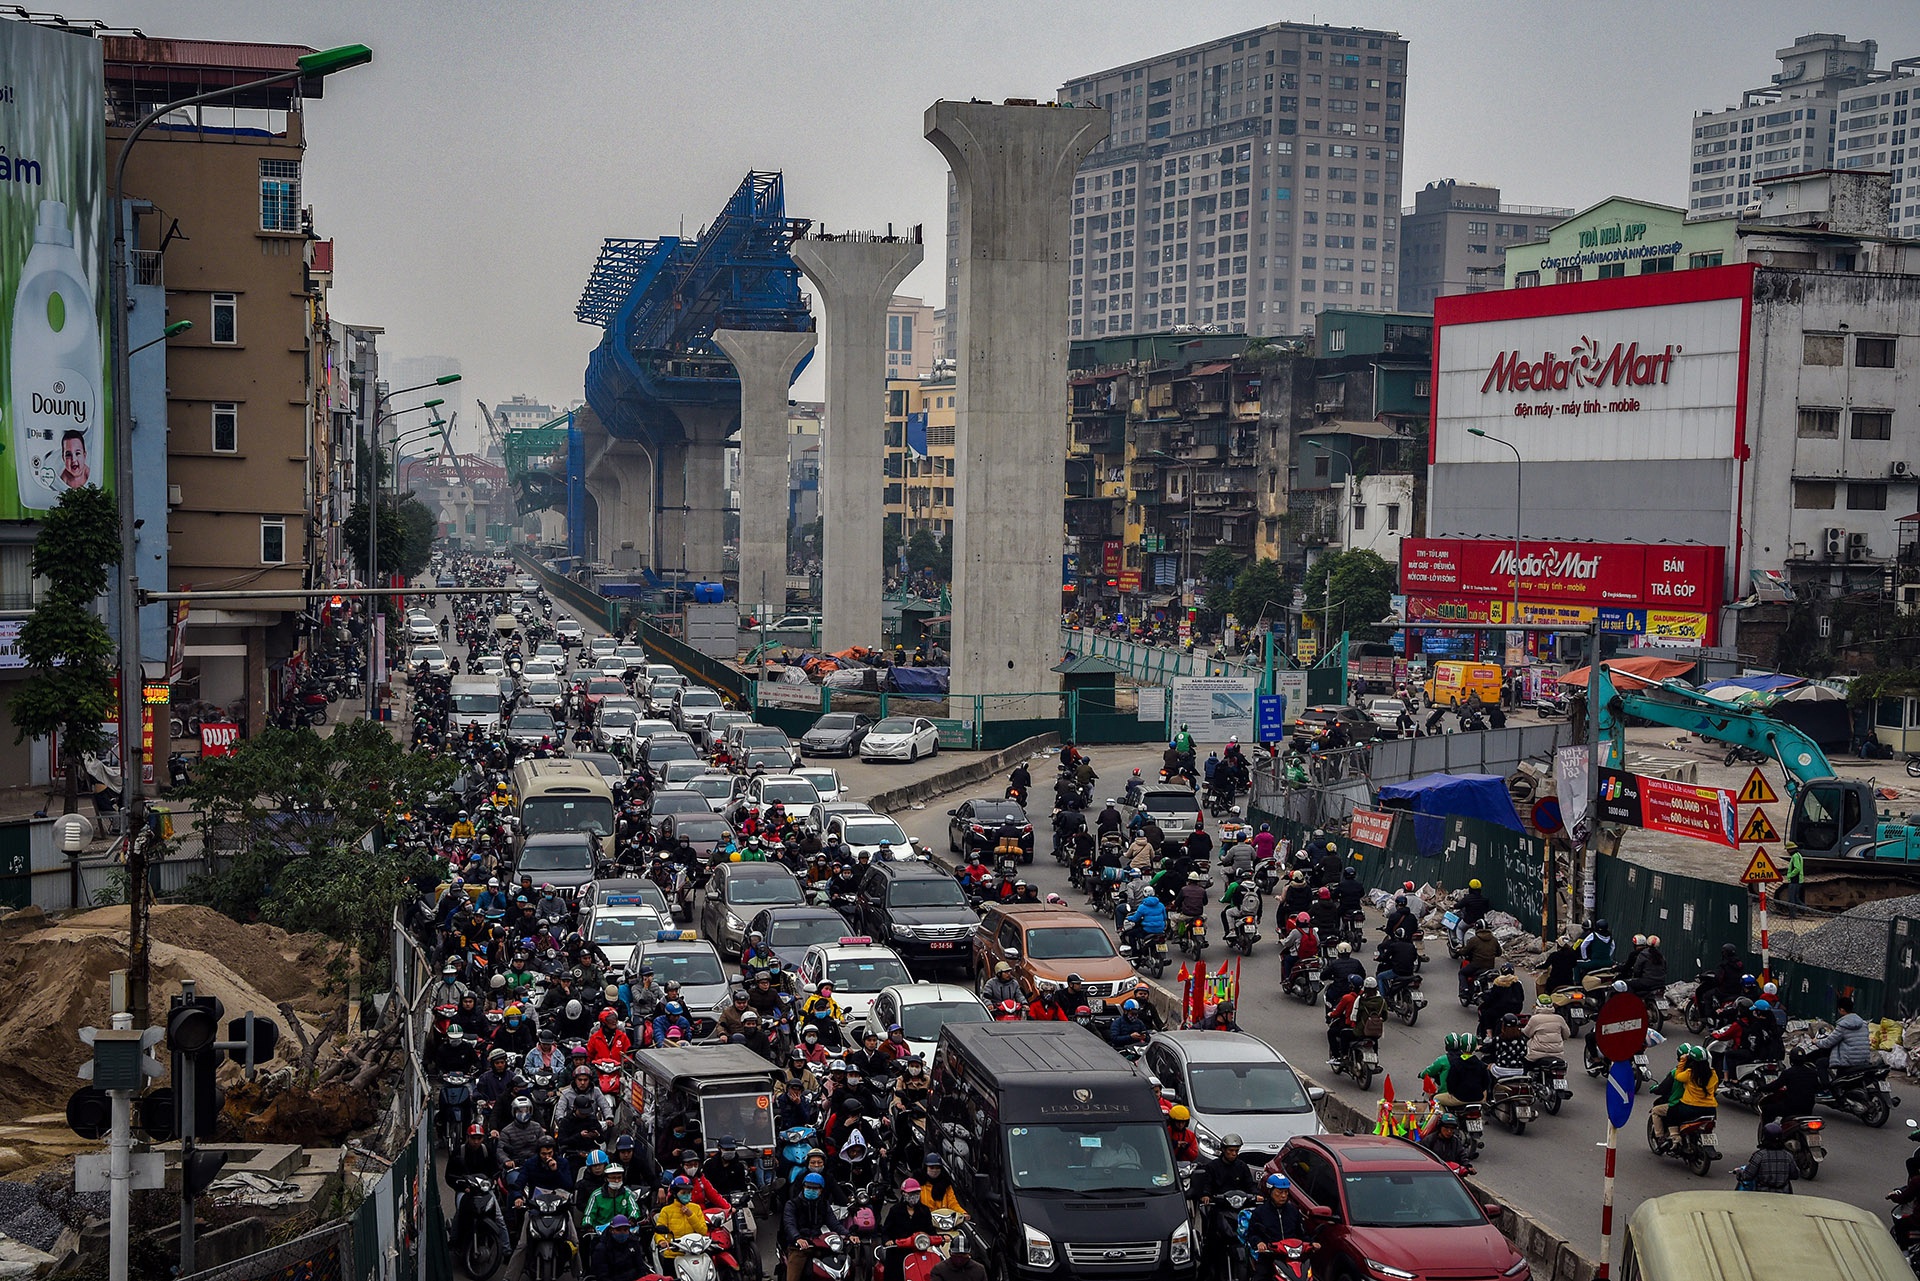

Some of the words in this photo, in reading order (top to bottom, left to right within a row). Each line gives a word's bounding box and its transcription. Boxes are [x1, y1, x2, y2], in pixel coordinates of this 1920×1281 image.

[1578, 227, 1598, 248] TOÀ
[1600, 223, 1622, 246] NHÀ
[1624, 223, 1646, 243] APP
[1541, 257, 1560, 269] CÔNG
[1561, 257, 1570, 267] TY
[1600, 251, 1613, 263] BAO
[1636, 243, 1658, 258] NÔNG
[1480, 350, 1571, 393] Media
[1594, 341, 1675, 388] Mart
[32, 392, 86, 423] Downy
[1514, 401, 1532, 418] điện
[1534, 401, 1554, 418] máy
[1561, 400, 1581, 417] máy
[1583, 399, 1601, 414] tính
[1609, 397, 1640, 413] mobile
[1490, 549, 1542, 577] Media
[1555, 551, 1599, 579] Mart
[1663, 557, 1685, 573] BÁN
[1520, 580, 1533, 591] máy
[1538, 581, 1550, 592] máy
[1566, 583, 1586, 592] mobile
[1651, 580, 1672, 596] TRẢ
[1673, 580, 1696, 597] GÓP
[1438, 601, 1456, 619] GIẢM
[1456, 602, 1468, 620] GIÁ
[1491, 610, 1502, 618] 50%
[1656, 624, 1673, 635] 30%
[1678, 625, 1696, 637] 50%
[1600, 780, 1622, 797] FPT
[1624, 788, 1637, 799] Shop
[1648, 780, 1662, 788] Xiaomi
[1668, 783, 1674, 791] A2
[1674, 784, 1682, 792] Lite
[1618, 807, 1629, 817] 6601
[1670, 812, 1682, 823] 600
[1041, 1103, 1130, 1113] LIMOUSINE
[1108, 1250, 1122, 1258] Ford
